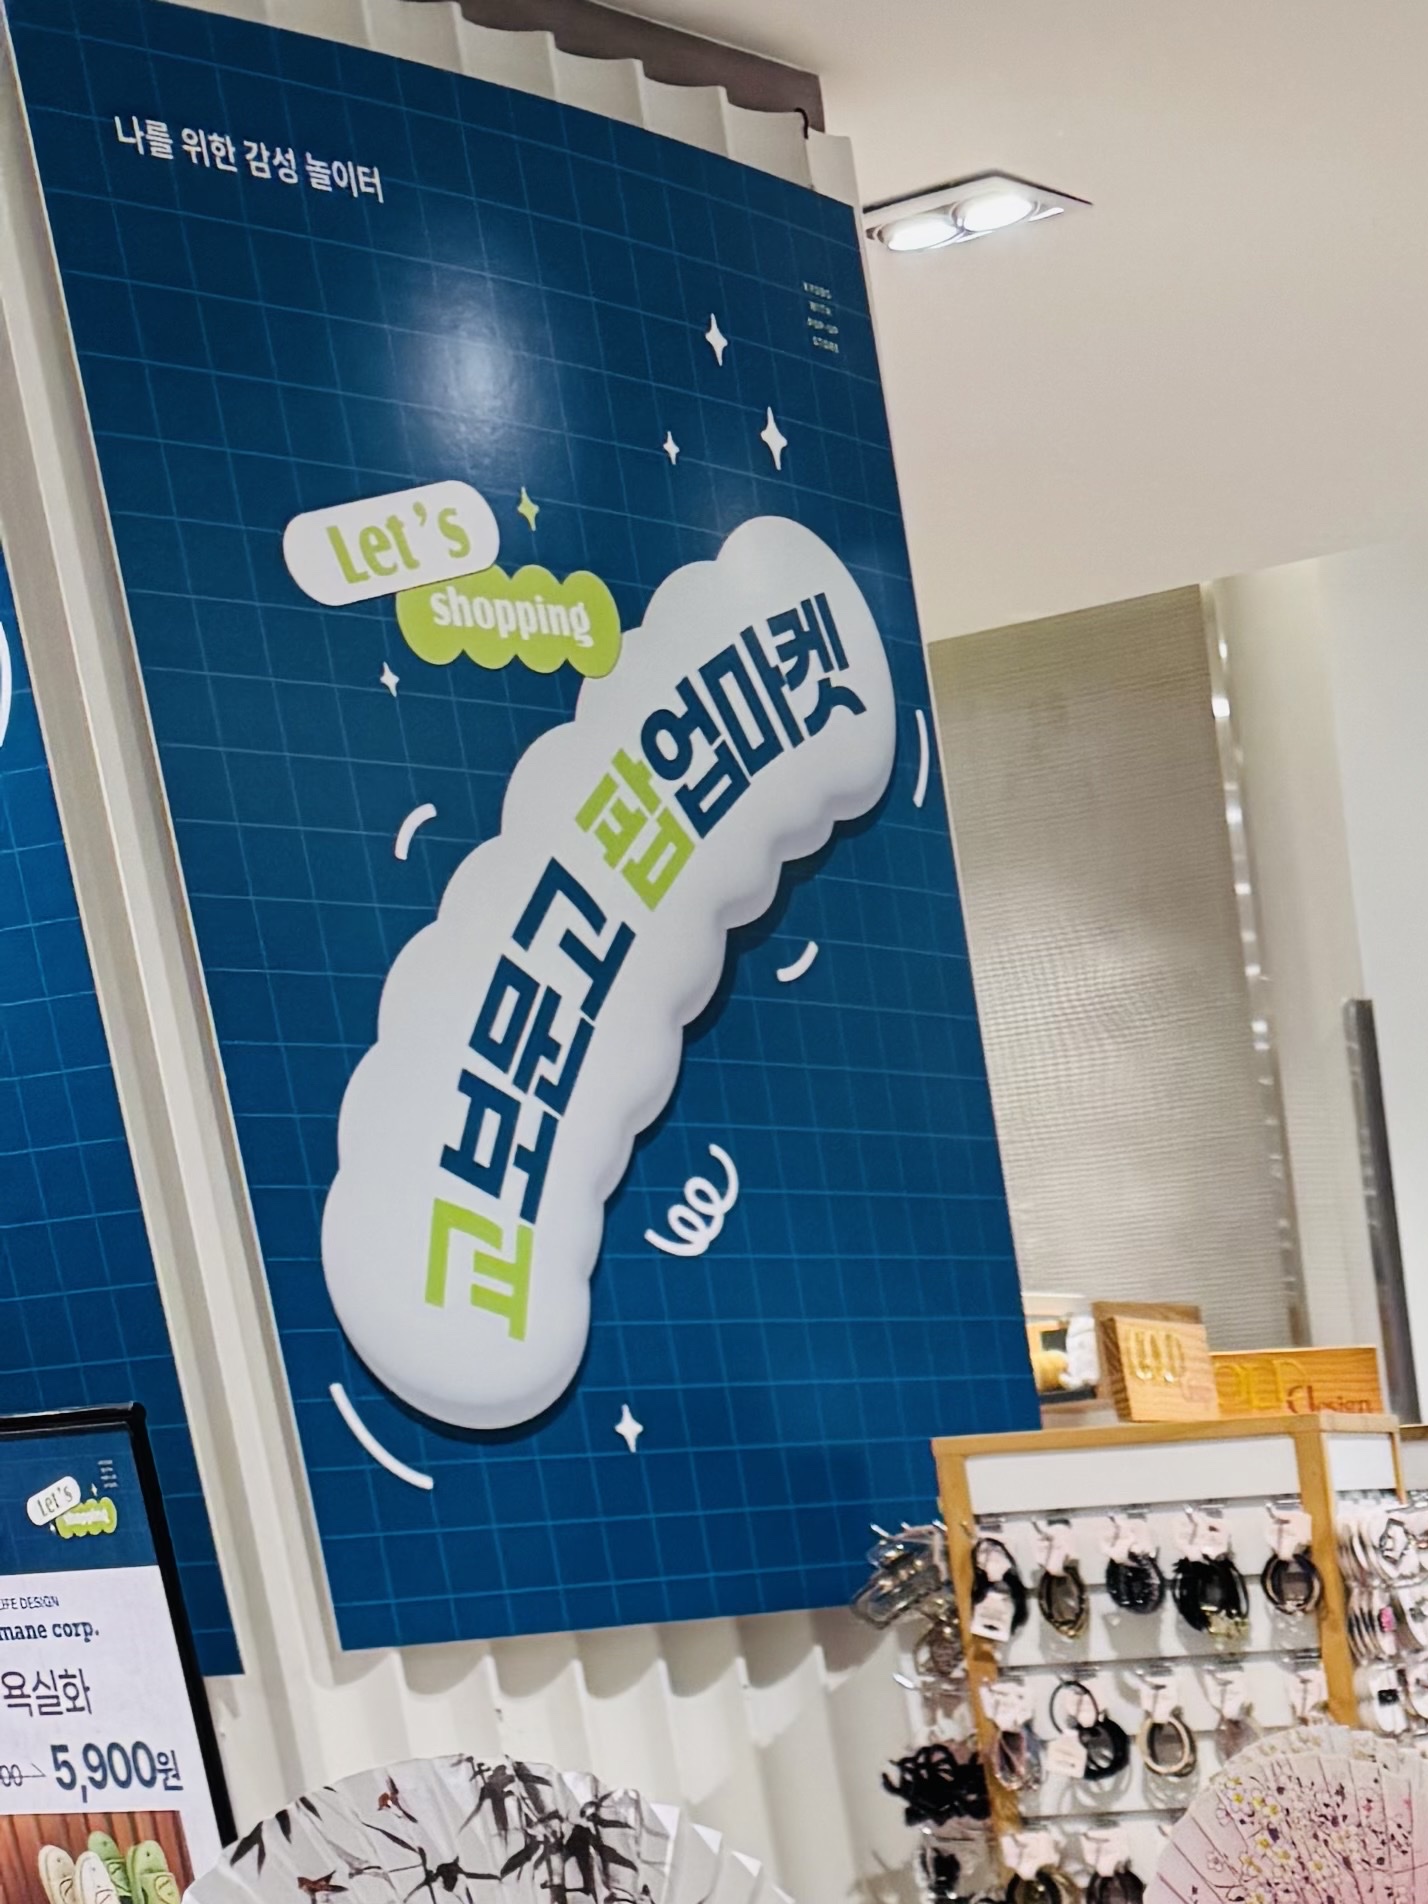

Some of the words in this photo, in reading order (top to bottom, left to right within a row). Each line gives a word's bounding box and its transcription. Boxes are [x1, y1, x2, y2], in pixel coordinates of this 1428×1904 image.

[114, 115, 175, 161] 나를
[181, 127, 239, 174] 위한
[243, 139, 299, 185] 감성
[305, 151, 385, 204] 놀이터
[325, 501, 472, 585] Let's
[429, 585, 595, 648] shopping
[574, 591, 868, 912] 팝업마켓
[423, 856, 637, 1342] 교보문고
[52, 1621, 100, 1643] corp.
[1, 1668, 92, 1717] 욕실화
[51, 1741, 184, 1804] 5,900원
